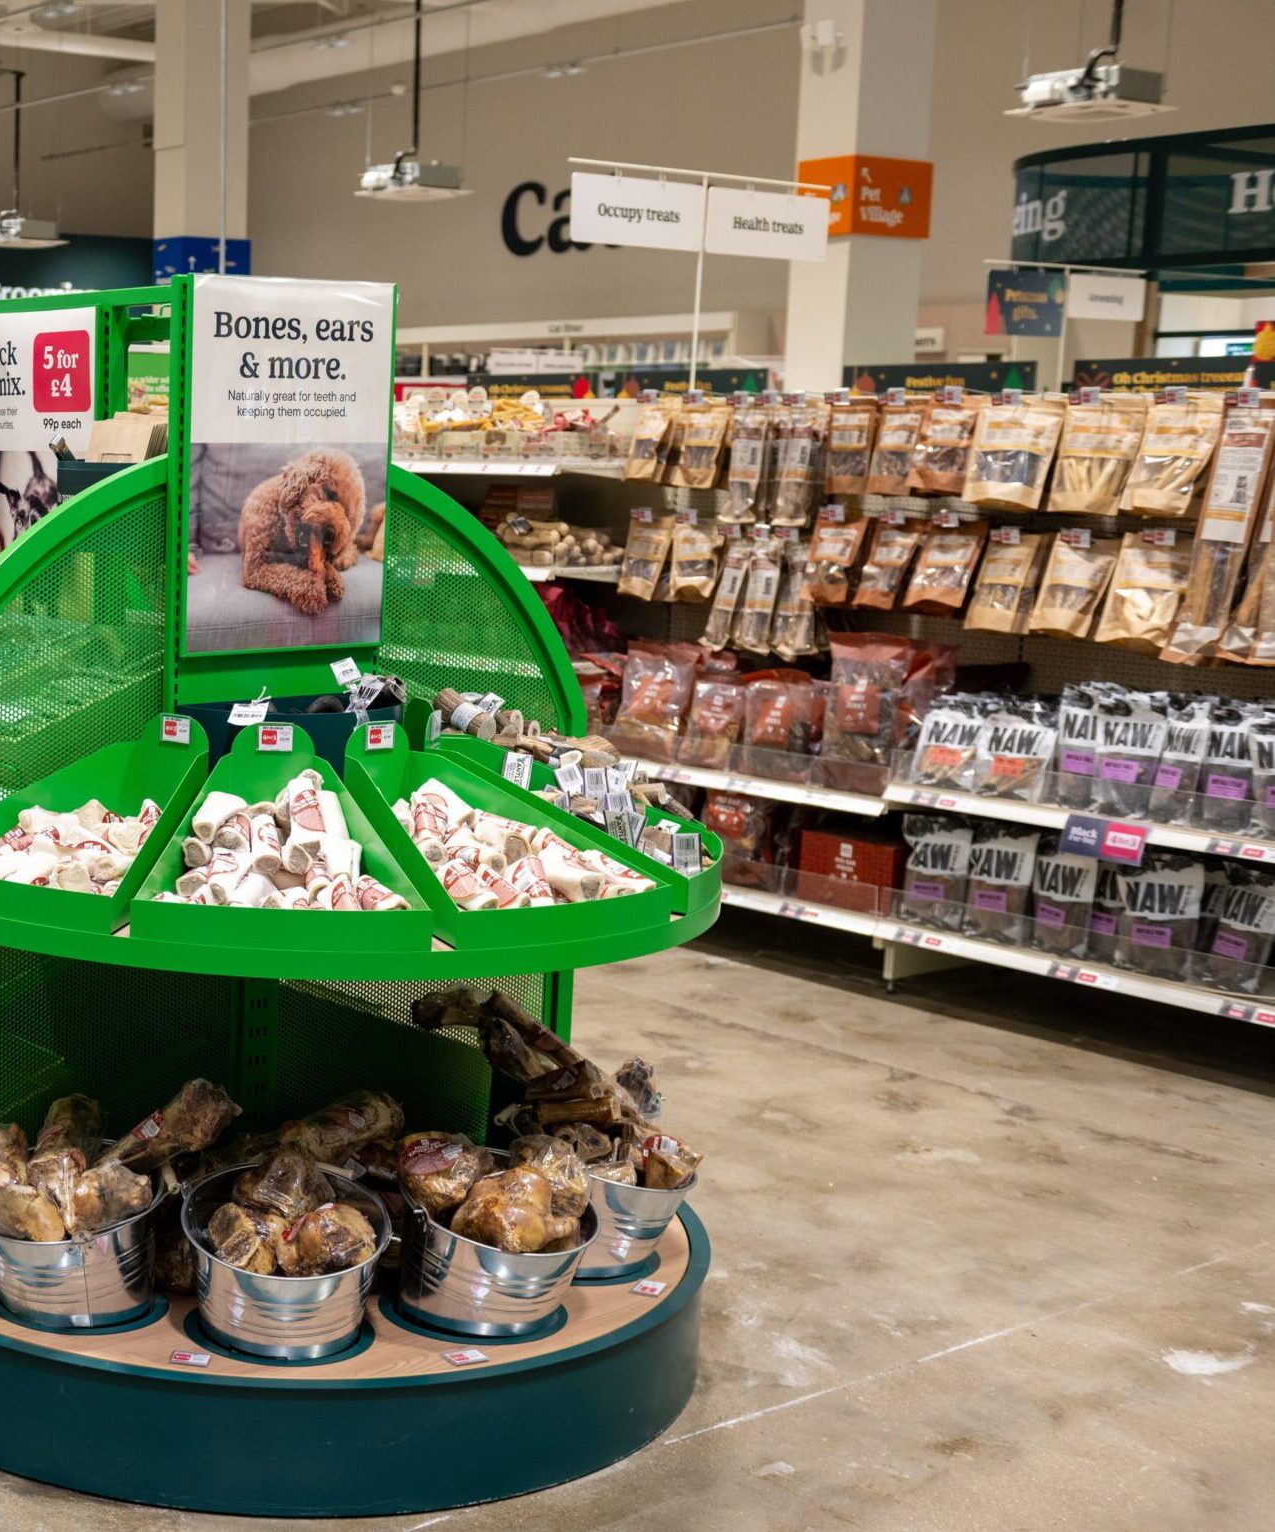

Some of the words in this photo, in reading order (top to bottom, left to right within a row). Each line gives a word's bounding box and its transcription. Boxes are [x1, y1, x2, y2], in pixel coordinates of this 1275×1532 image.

[597, 202, 644, 224] Occupy
[646, 208, 680, 224] treats
[859, 205, 905, 228] Village
[732, 216, 770, 232] Health
[772, 220, 804, 235] treats
[213, 311, 308, 344] Bones,
[315, 317, 374, 342] ears
[42, 345, 54, 370] 5
[56, 349, 79, 369] for
[239, 351, 260, 379] &
[268, 356, 346, 380] more.
[50, 373, 73, 397] £4
[227, 389, 271, 402] Naturally
[272, 390, 296, 403] great
[299, 390, 311, 402] for
[313, 391, 337, 402] teeth
[339, 391, 357, 402] and
[6, 406, 18, 416] their
[237, 405, 275, 419] keeping
[277, 406, 301, 417] them
[303, 407, 348, 418] occupied.
[42, 417, 59, 431] 99p
[61, 418, 82, 429] each
